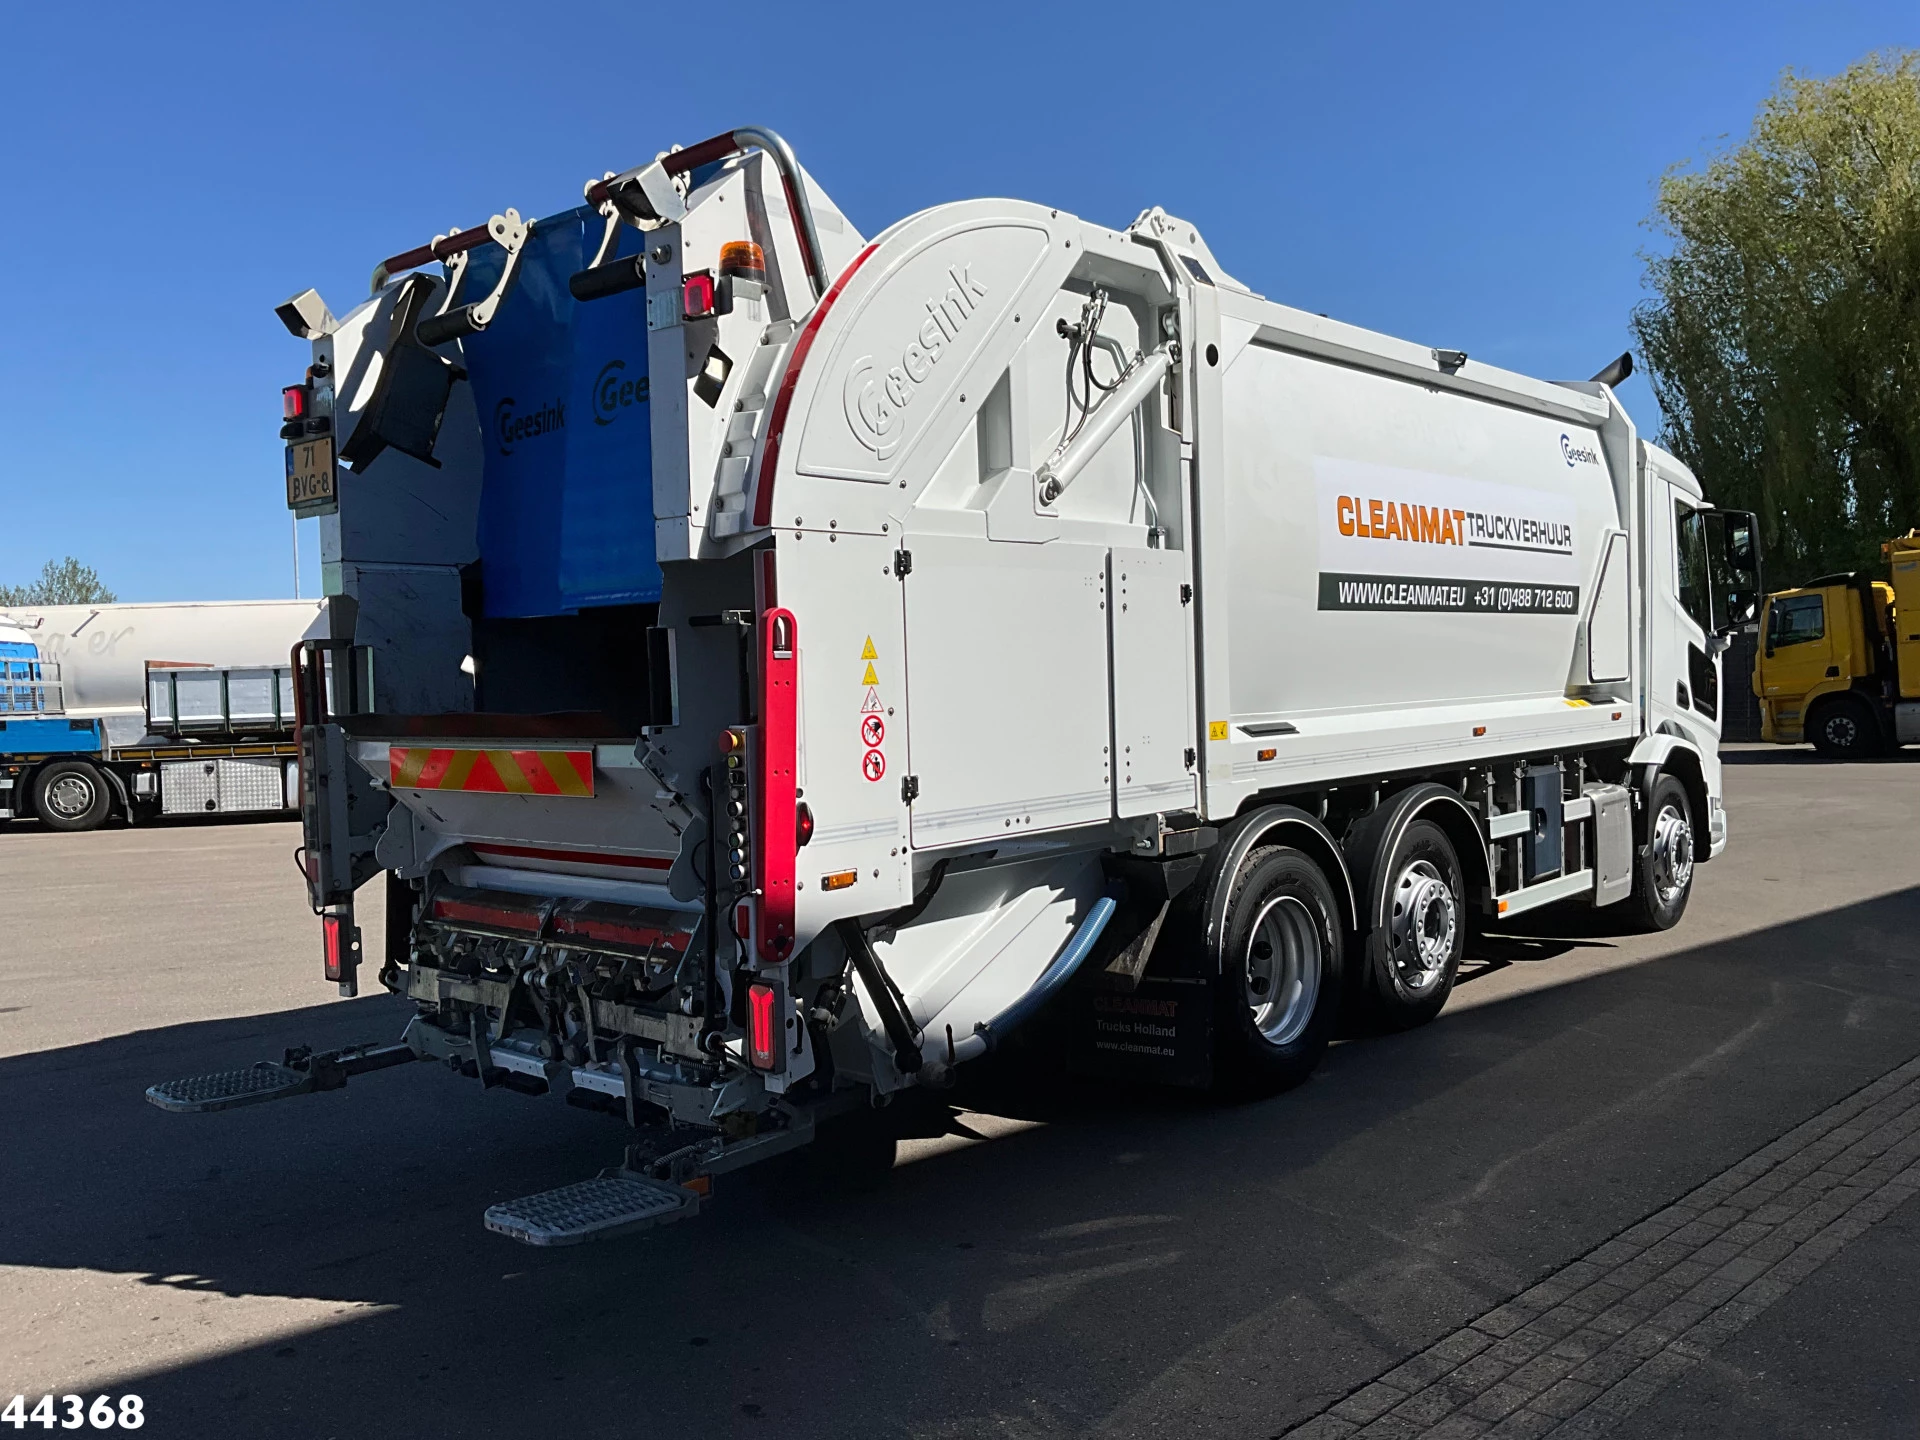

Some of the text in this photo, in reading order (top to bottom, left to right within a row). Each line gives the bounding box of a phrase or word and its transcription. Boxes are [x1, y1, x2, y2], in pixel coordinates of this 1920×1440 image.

[843, 262, 988, 460] Geesink
[494, 396, 566, 457] Geesink
[303, 445, 315, 469] 71
[1560, 433, 1599, 467] Geesink
[293, 472, 331, 500] BVG-8
[1337, 495, 1572, 547] CLEANMAT TRUCKVERHUUR
[1339, 580, 1573, 611] WWW.CLEANMAT.EU +31 (0)488 712 600
[1093, 996, 1178, 1018] CLEANMAT
[1096, 1019, 1176, 1038] Trucks Holland
[1096, 1041, 1175, 1056] www.cleanmat.eu
